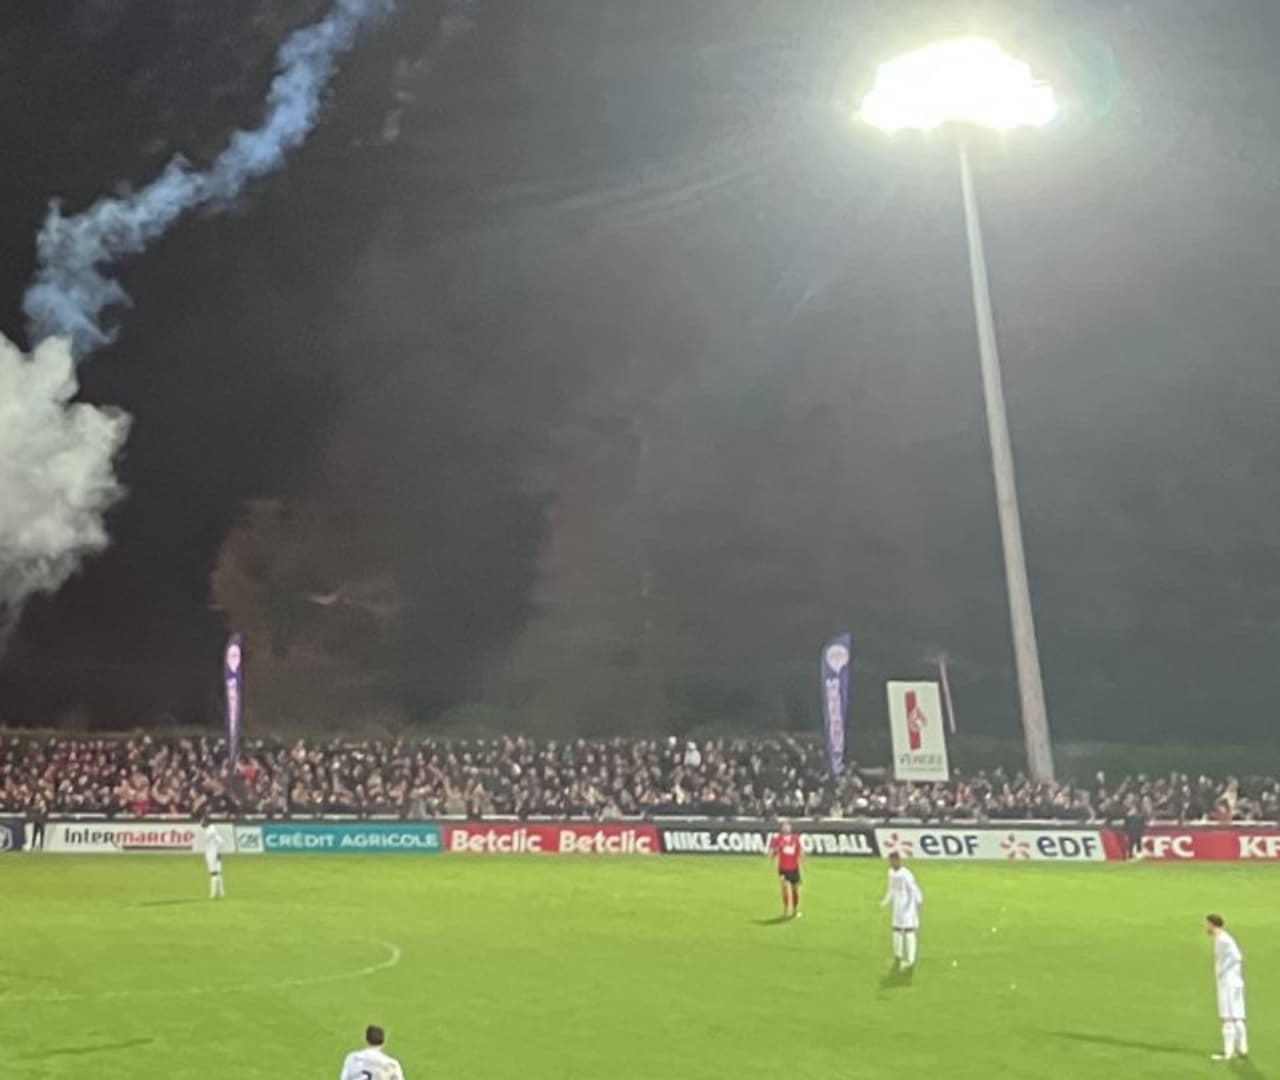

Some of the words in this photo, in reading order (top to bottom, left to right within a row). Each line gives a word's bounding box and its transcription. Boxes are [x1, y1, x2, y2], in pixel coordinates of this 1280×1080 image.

[265, 831, 333, 848] CRÉDIT
[339, 833, 438, 847] AGRICOLE
[451, 828, 542, 852] Betclic
[559, 829, 651, 853] Betclic
